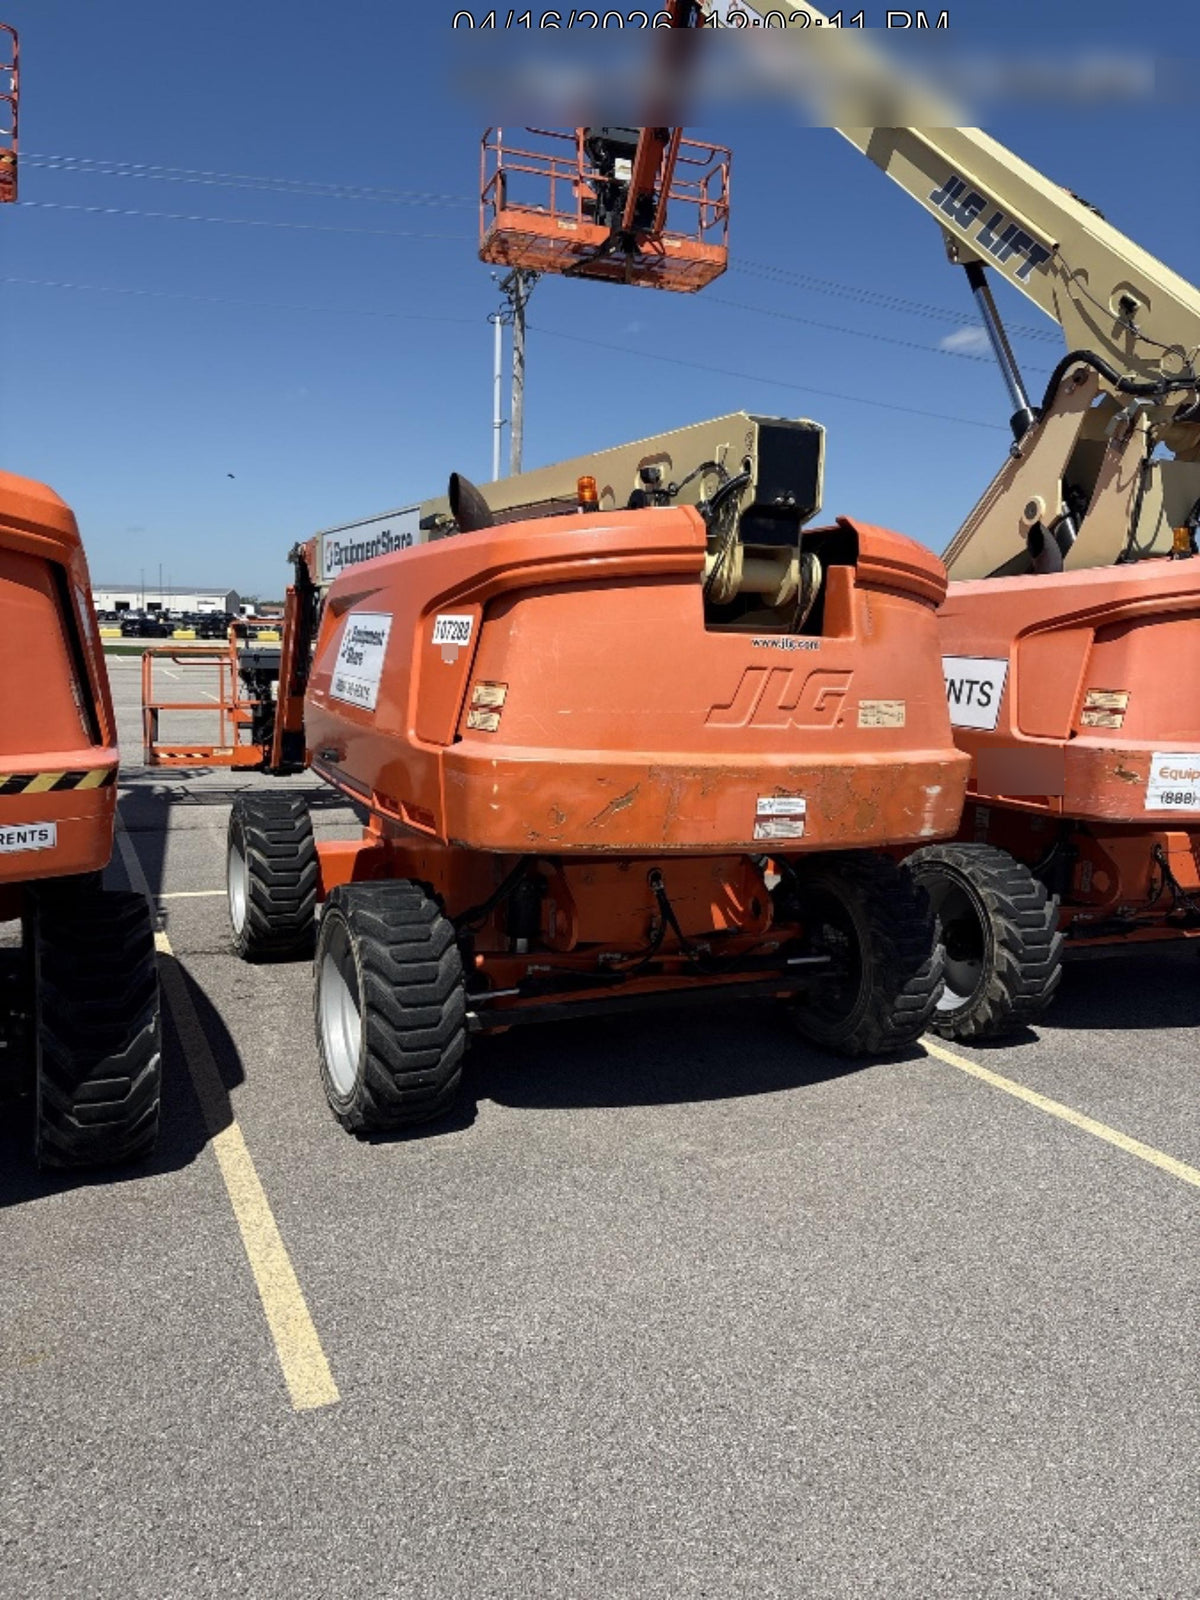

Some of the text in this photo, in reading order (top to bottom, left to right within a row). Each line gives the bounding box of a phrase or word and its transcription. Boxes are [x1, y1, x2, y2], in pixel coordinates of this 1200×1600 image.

[928, 175, 1053, 281] JLG LIFT
[751, 638, 819, 651] www.jlg.com
[704, 665, 854, 729] JLG
[944, 678, 994, 708] NTS
[1160, 791, 1197, 806] (888)
